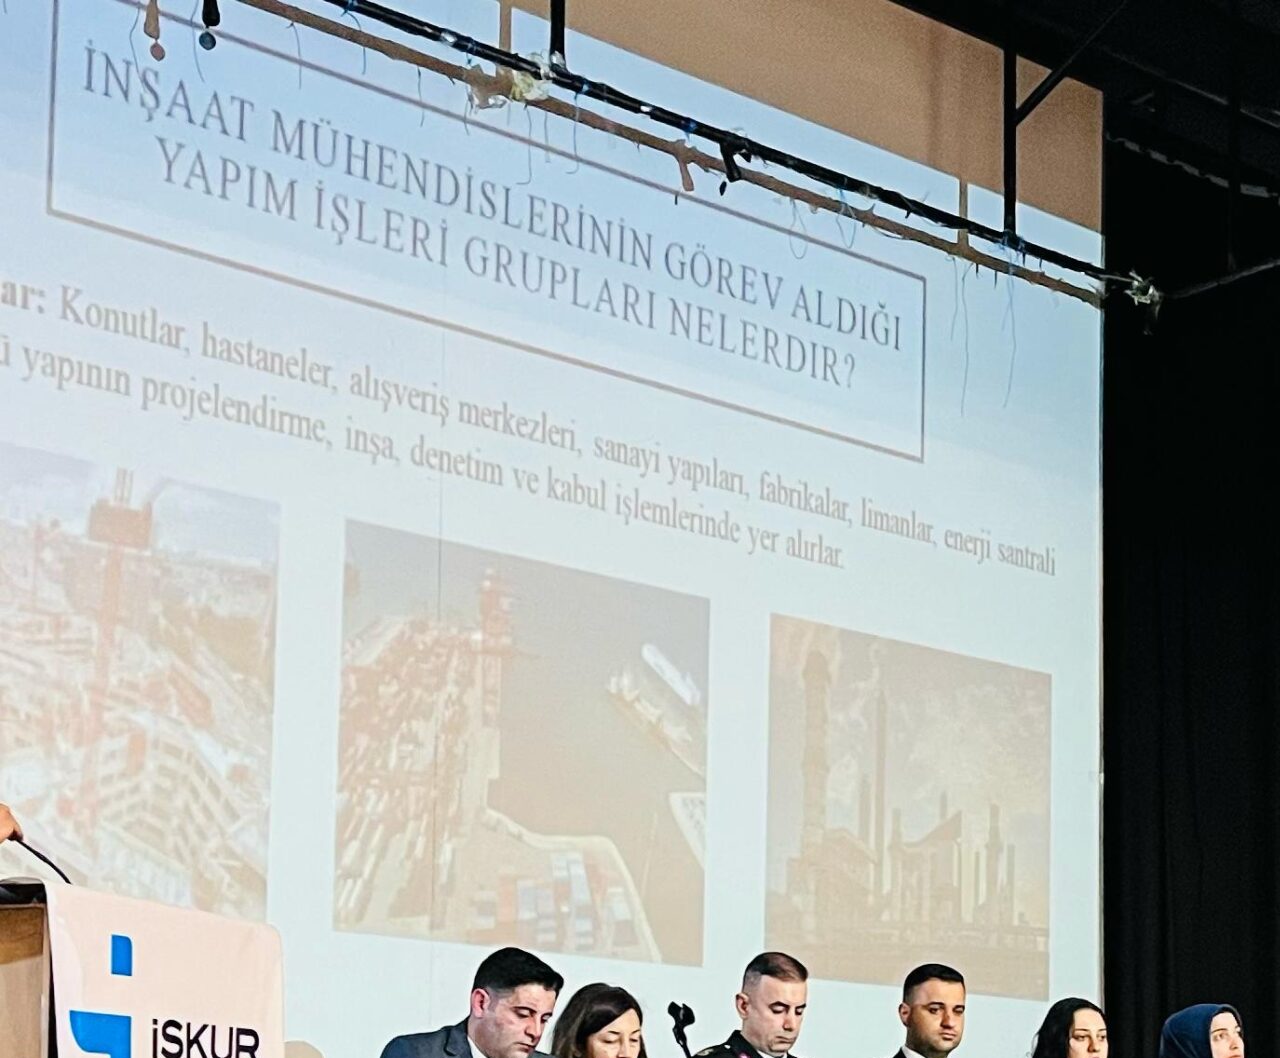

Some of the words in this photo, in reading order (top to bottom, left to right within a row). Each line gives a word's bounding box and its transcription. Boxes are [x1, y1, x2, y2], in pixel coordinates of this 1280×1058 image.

[83, 39, 254, 142] İNŞAAT
[272, 108, 653, 271] MÜHENDİSLERİNİN
[665, 242, 783, 310] GÖREV
[791, 284, 900, 351] ALDIĞI
[155, 135, 297, 221] YAPIM
[315, 180, 448, 268] İŞLERİ
[464, 235, 656, 329] GRUPLARI
[21, 345, 131, 397] yapının
[141, 375, 333, 452] projelendirme,
[345, 415, 400, 465] inşa,
[410, 434, 503, 486] denetim
[513, 467, 539, 494] ve
[546, 466, 606, 511] kabul
[615, 482, 740, 544] işlemlerinde
[747, 525, 780, 555] yer
[60, 285, 190, 356] Konutlar,
[201, 322, 338, 394] hastaneler,
[350, 365, 449, 427] alışveriş
[458, 402, 582, 457] merkezleri,
[593, 436, 661, 477] sanayi
[667, 454, 750, 499] yapıları,
[759, 471, 852, 528] fabrikalar,
[861, 497, 938, 548] limanlar,
[944, 528, 992, 564] enerji
[998, 542, 1056, 576] santrali
